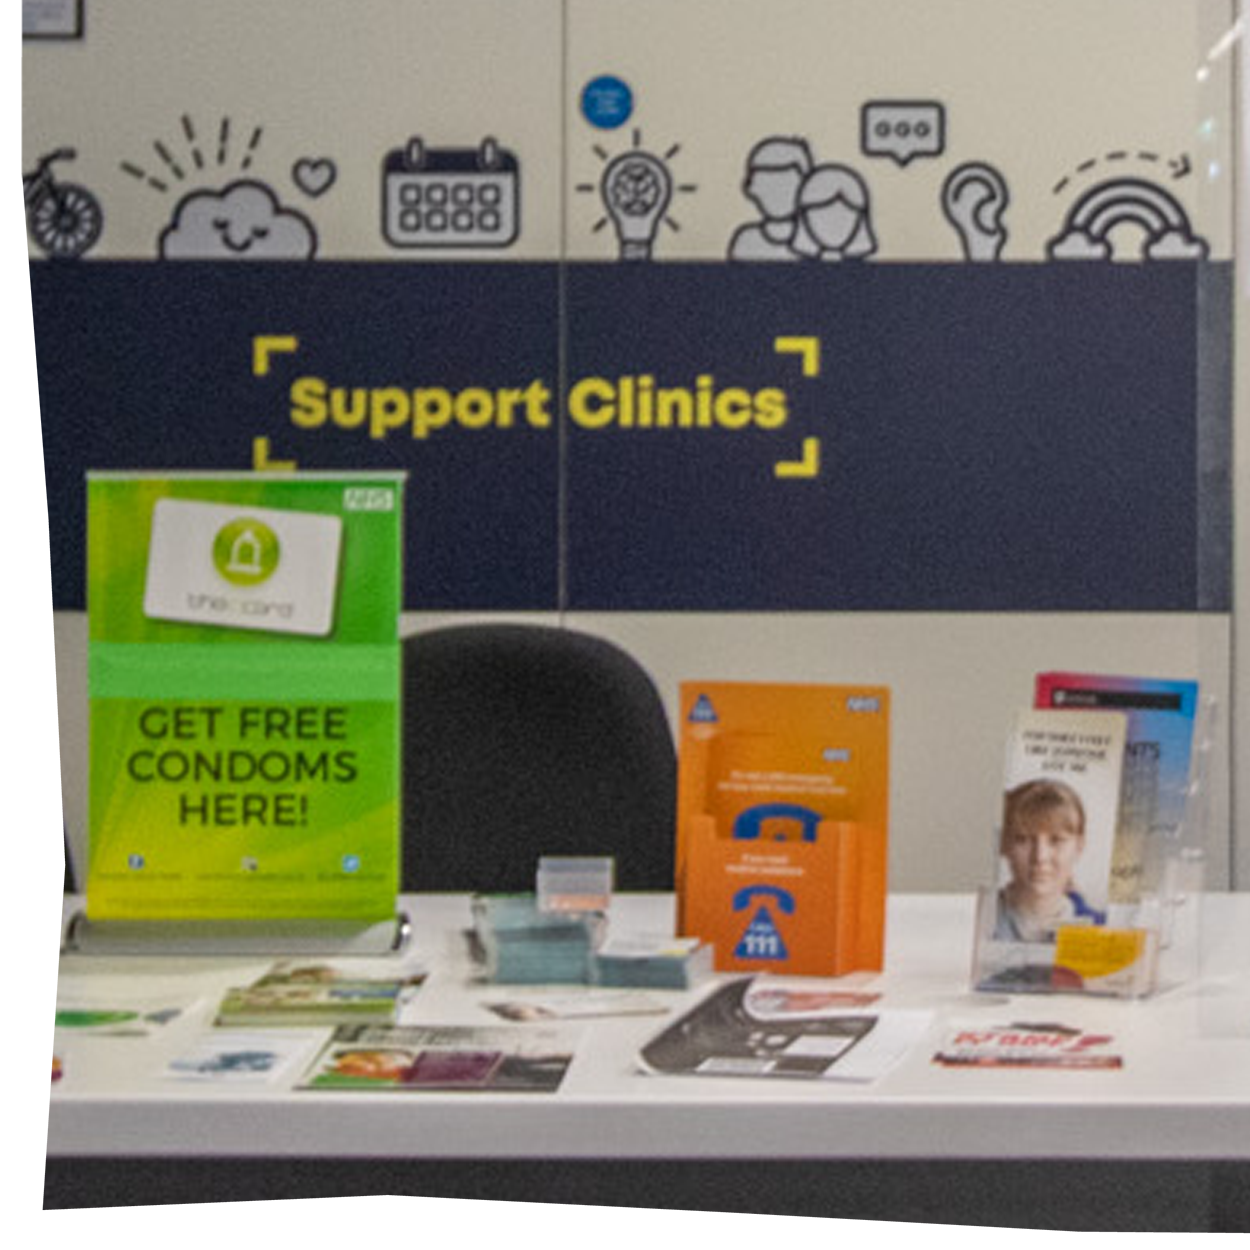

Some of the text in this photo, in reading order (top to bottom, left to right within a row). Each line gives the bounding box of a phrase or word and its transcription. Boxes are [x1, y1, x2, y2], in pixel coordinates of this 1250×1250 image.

[290, 375, 788, 439] Support Clinics
[139, 707, 348, 740] GET FREE
[128, 751, 358, 783] CONDOMS
[178, 794, 308, 827] HERE!
[745, 936, 778, 955] 111
